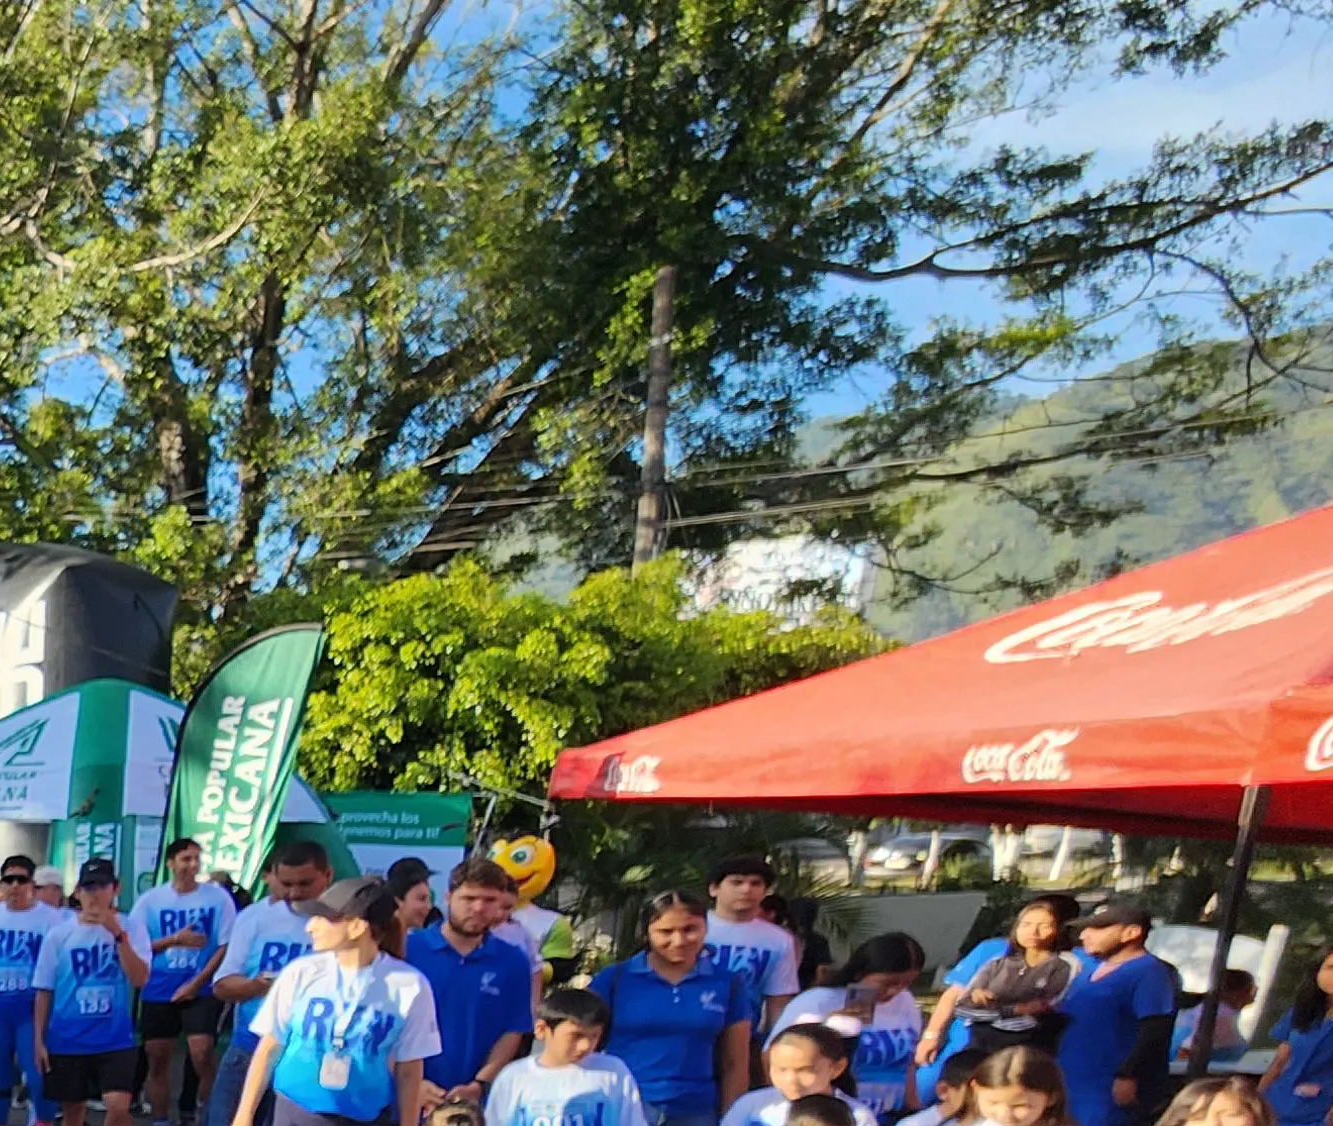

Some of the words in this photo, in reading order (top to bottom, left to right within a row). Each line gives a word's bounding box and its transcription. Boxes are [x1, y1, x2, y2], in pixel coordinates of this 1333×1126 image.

[197, 695, 246, 823] POPULAR
[339, 811, 398, 825] provecha
[340, 826, 391, 838] enemos
